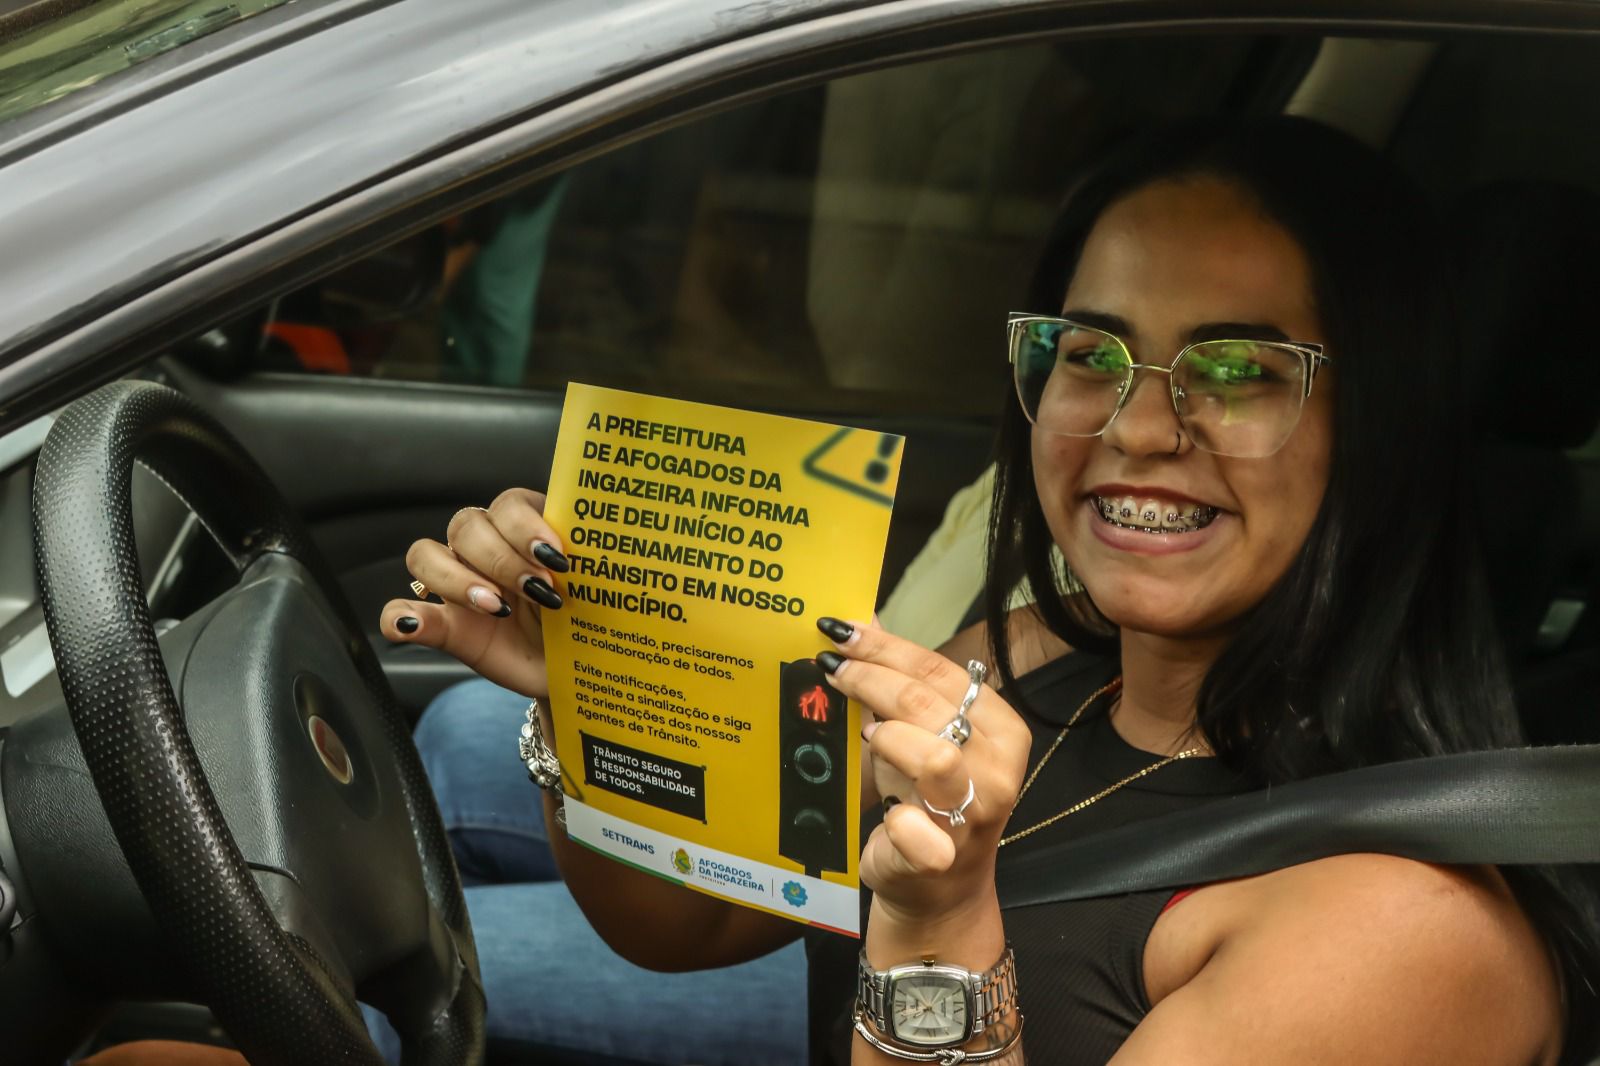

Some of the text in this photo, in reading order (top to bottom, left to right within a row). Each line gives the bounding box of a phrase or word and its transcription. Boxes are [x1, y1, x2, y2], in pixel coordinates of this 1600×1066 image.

[587, 412, 746, 456] A PREFEITURA
[583, 440, 782, 492] DE AFOGADOS DA
[578, 469, 810, 527] INGAZEIRA INFORMA
[574, 498, 783, 552] QUE DEU INÍCIO AO
[570, 527, 784, 583] ORDENAMENTO DO
[568, 553, 805, 616] TRÂNSITO EM NOSSO
[568, 582, 687, 623] MUNICÍPIO.
[570, 616, 754, 669] Nesse sentido, precisaremos
[572, 631, 735, 681] da colaboração de todos.
[574, 660, 686, 702] Evite notificações,
[575, 677, 752, 732] respeite a sinalização e siga
[576, 692, 741, 744] as orientações dos nossos
[577, 705, 701, 749] Agentes de Trânsito.
[593, 744, 681, 780] TRÂNSITO SEGURO
[594, 757, 696, 798] É RESPONSABILIDADE
[595, 770, 645, 795] DE TODOS.
[601, 827, 655, 855] SETTRANS
[698, 858, 752, 880] AFOGADOS
[699, 866, 712, 877] DA
[713, 871, 765, 893] INGAZEIRA
